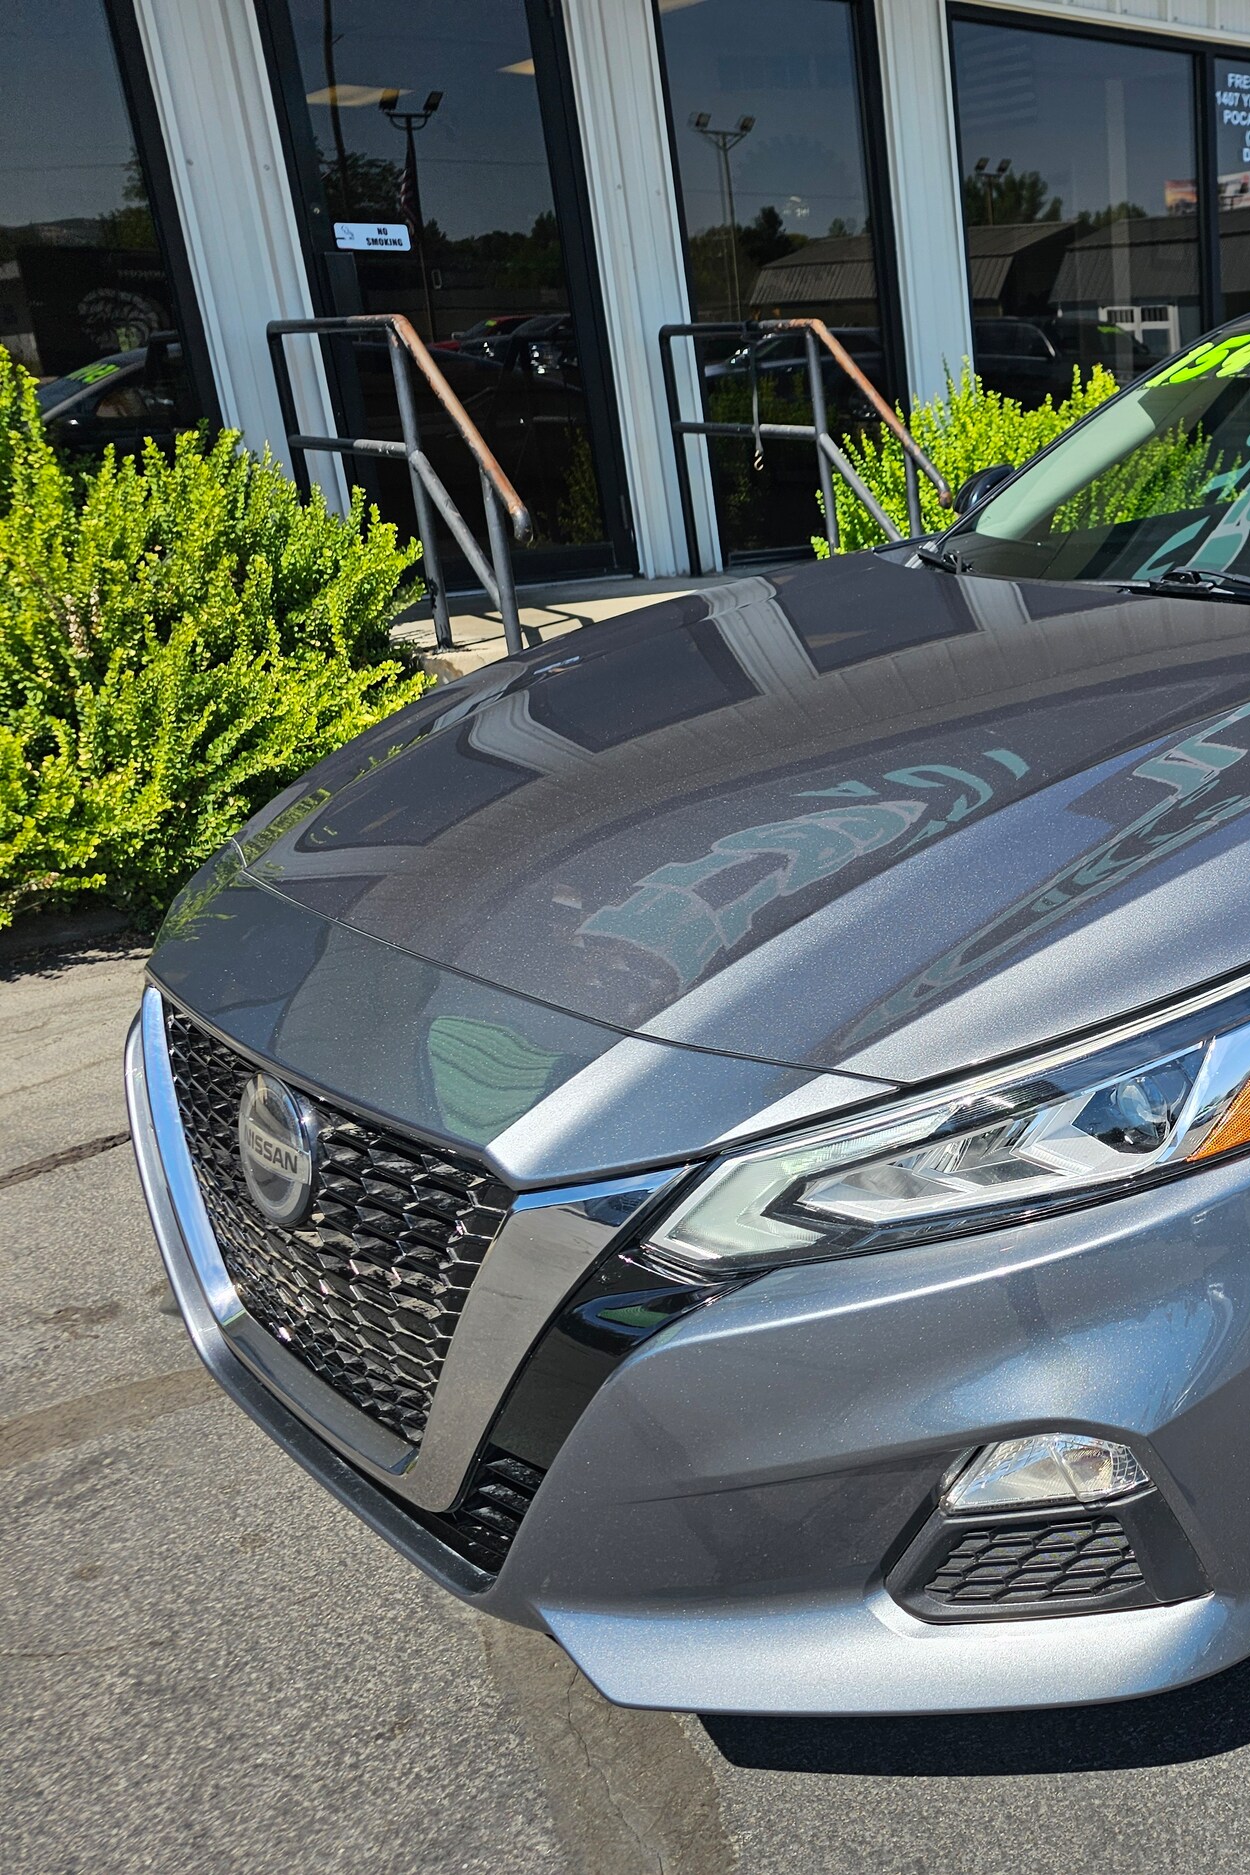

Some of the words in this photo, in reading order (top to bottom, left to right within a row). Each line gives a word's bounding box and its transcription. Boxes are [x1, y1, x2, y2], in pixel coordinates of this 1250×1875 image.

[376, 227, 389, 236] NO
[365, 237, 403, 247] SMOKING
[244, 1124, 298, 1174] NISSAN
